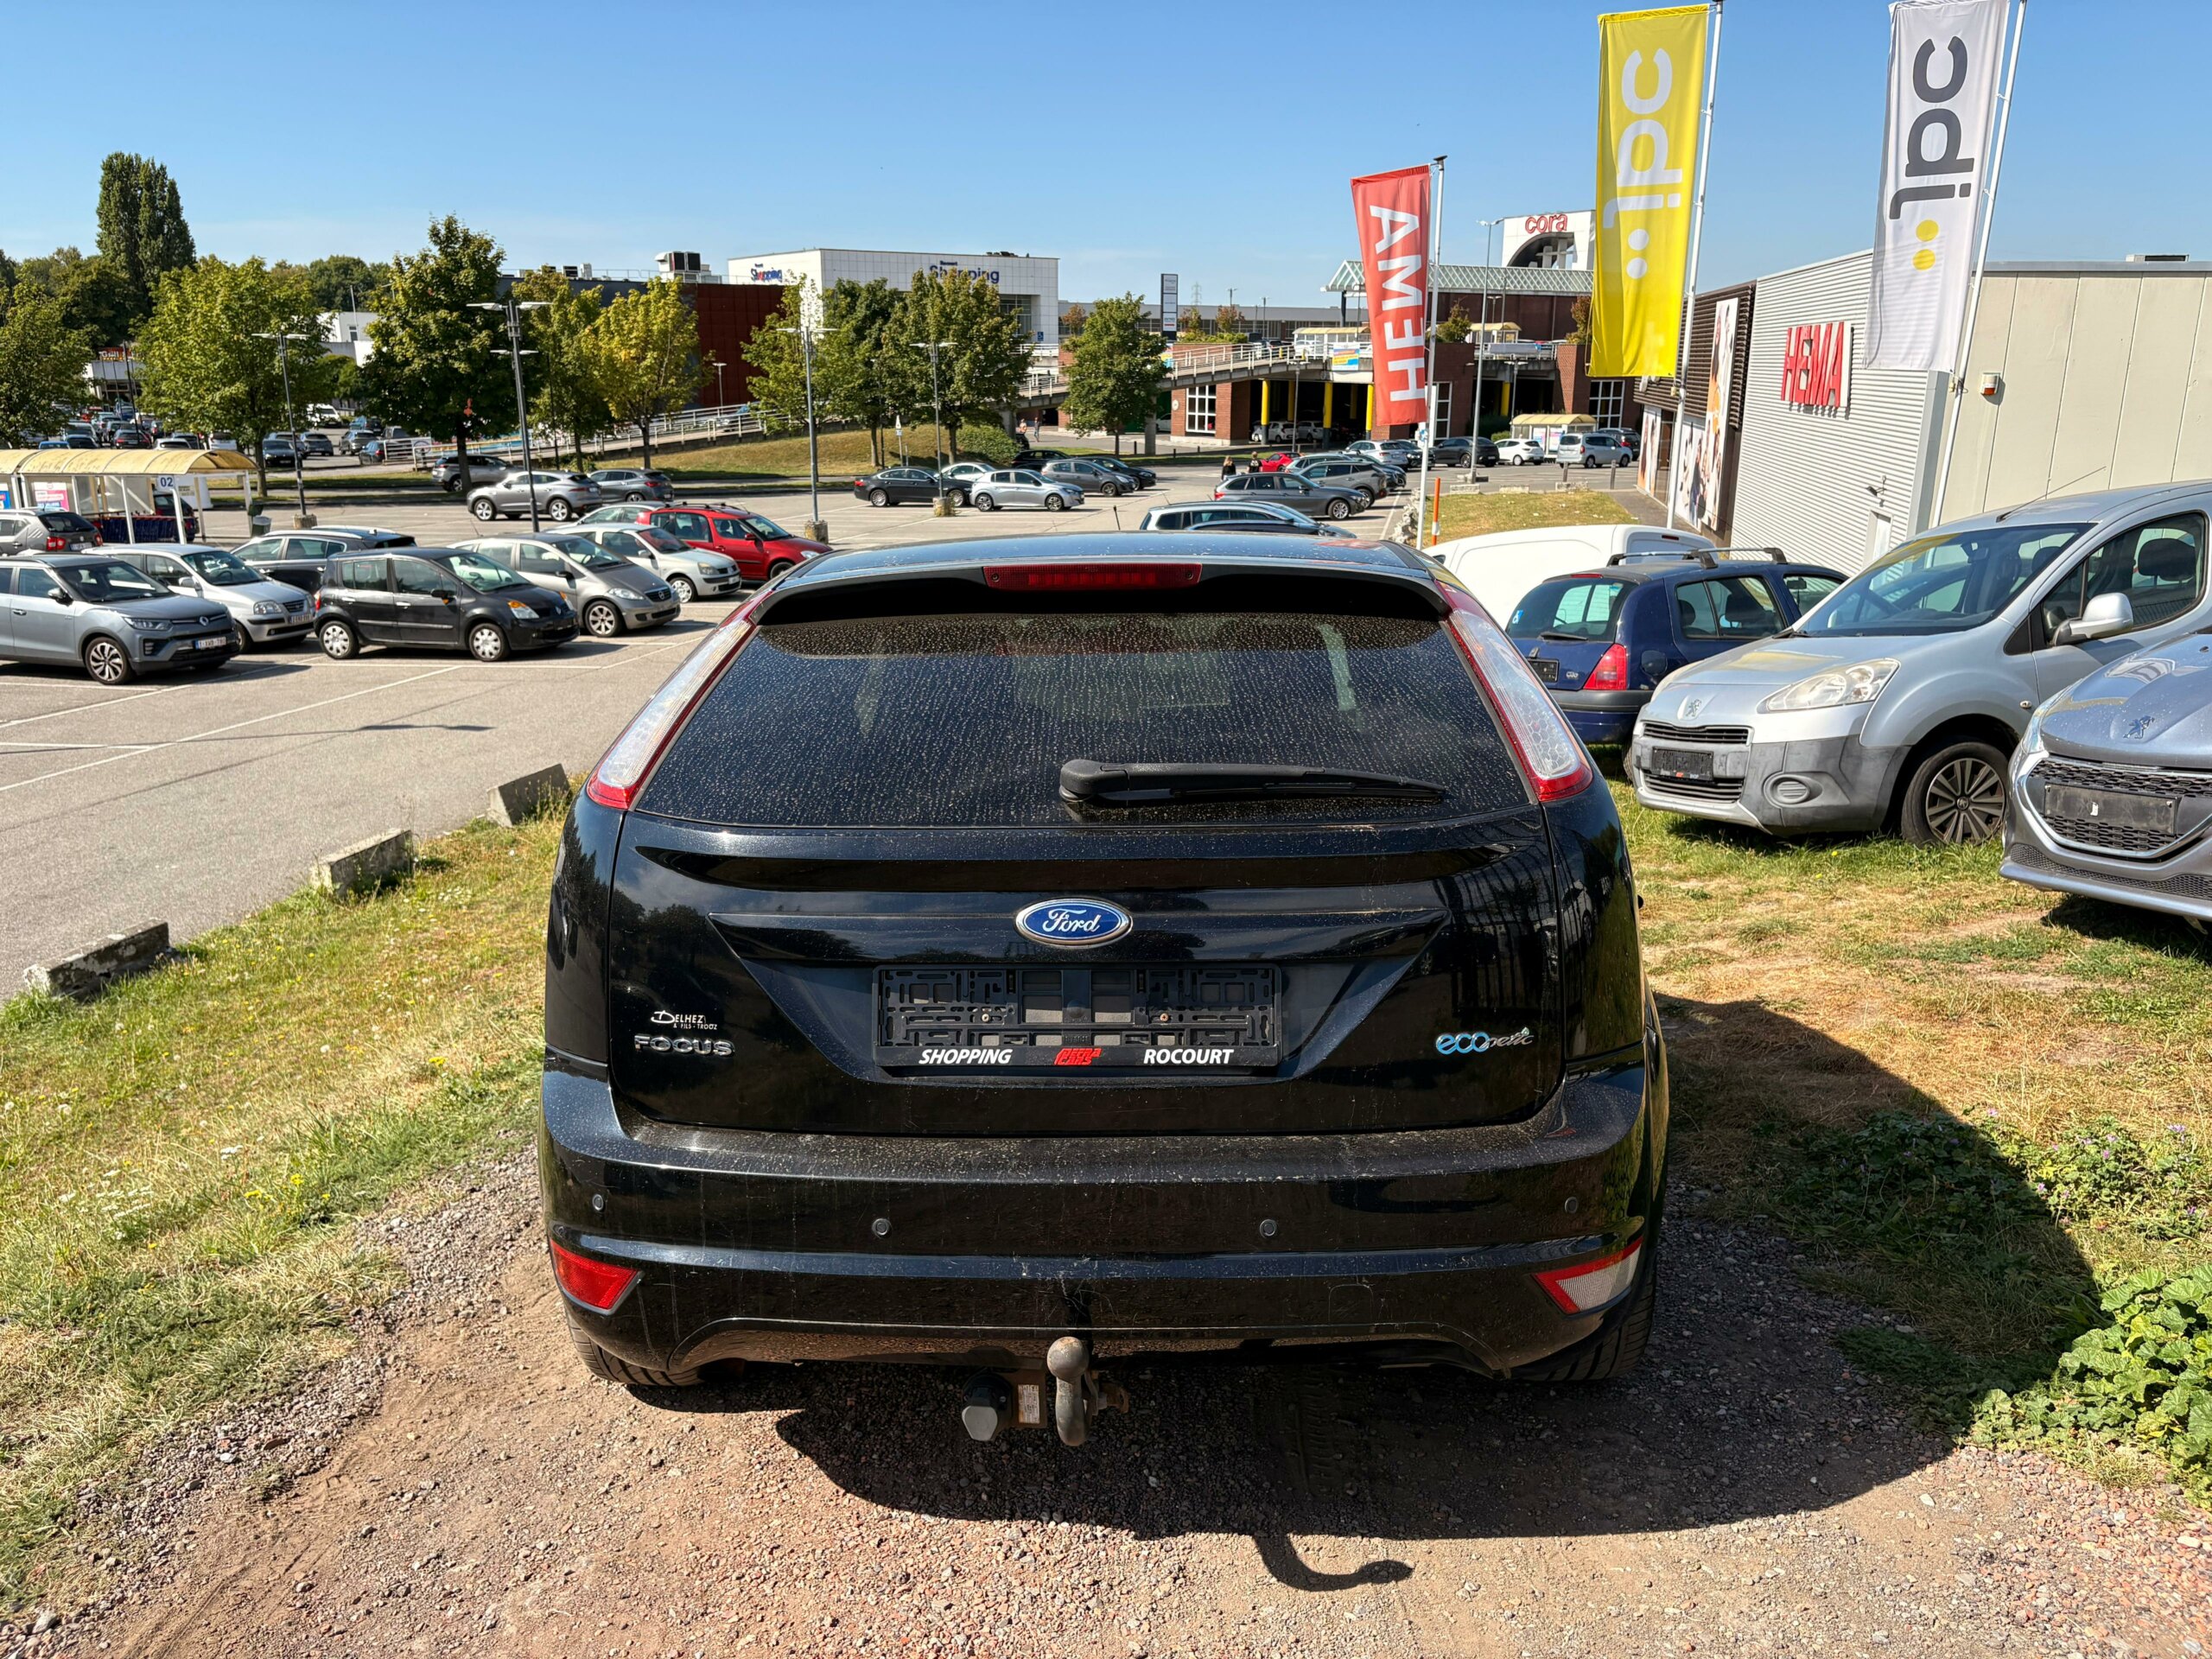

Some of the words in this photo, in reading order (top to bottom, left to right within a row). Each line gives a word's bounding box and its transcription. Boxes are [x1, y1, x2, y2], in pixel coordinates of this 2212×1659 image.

[1525, 214, 1568, 234] cora
[929, 264, 1000, 284] Shping
[1781, 321, 1845, 408] HEMA
[160, 477, 174, 487] 02
[1042, 907, 1102, 935] Ford
[651, 1010, 704, 1024] DELHEZ
[633, 1034, 734, 1056] FOCUS
[918, 1048, 1013, 1065] SHOPPING
[1143, 1048, 1236, 1065] ROCOURT
